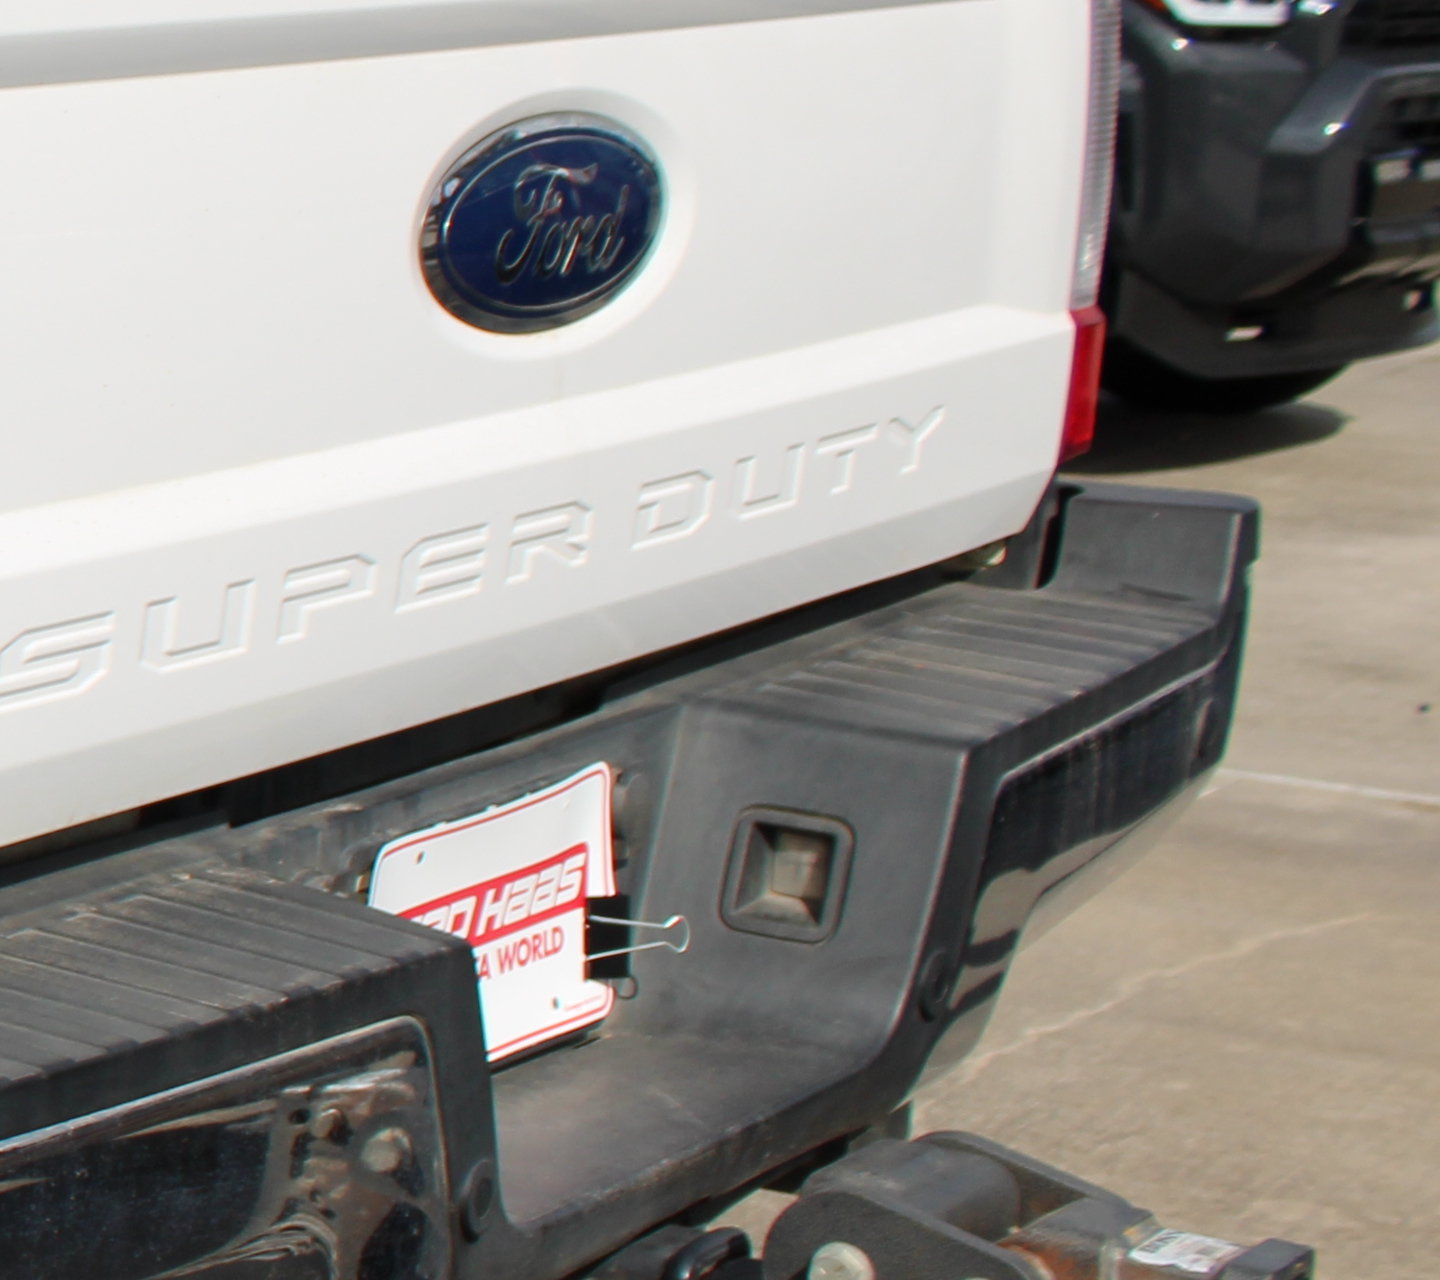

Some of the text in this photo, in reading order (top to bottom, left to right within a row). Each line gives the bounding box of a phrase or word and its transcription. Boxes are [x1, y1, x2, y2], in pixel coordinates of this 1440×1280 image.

[494, 162, 631, 288] Ford
[629, 403, 946, 552] DUTY
[496, 925, 565, 974] WORLD
